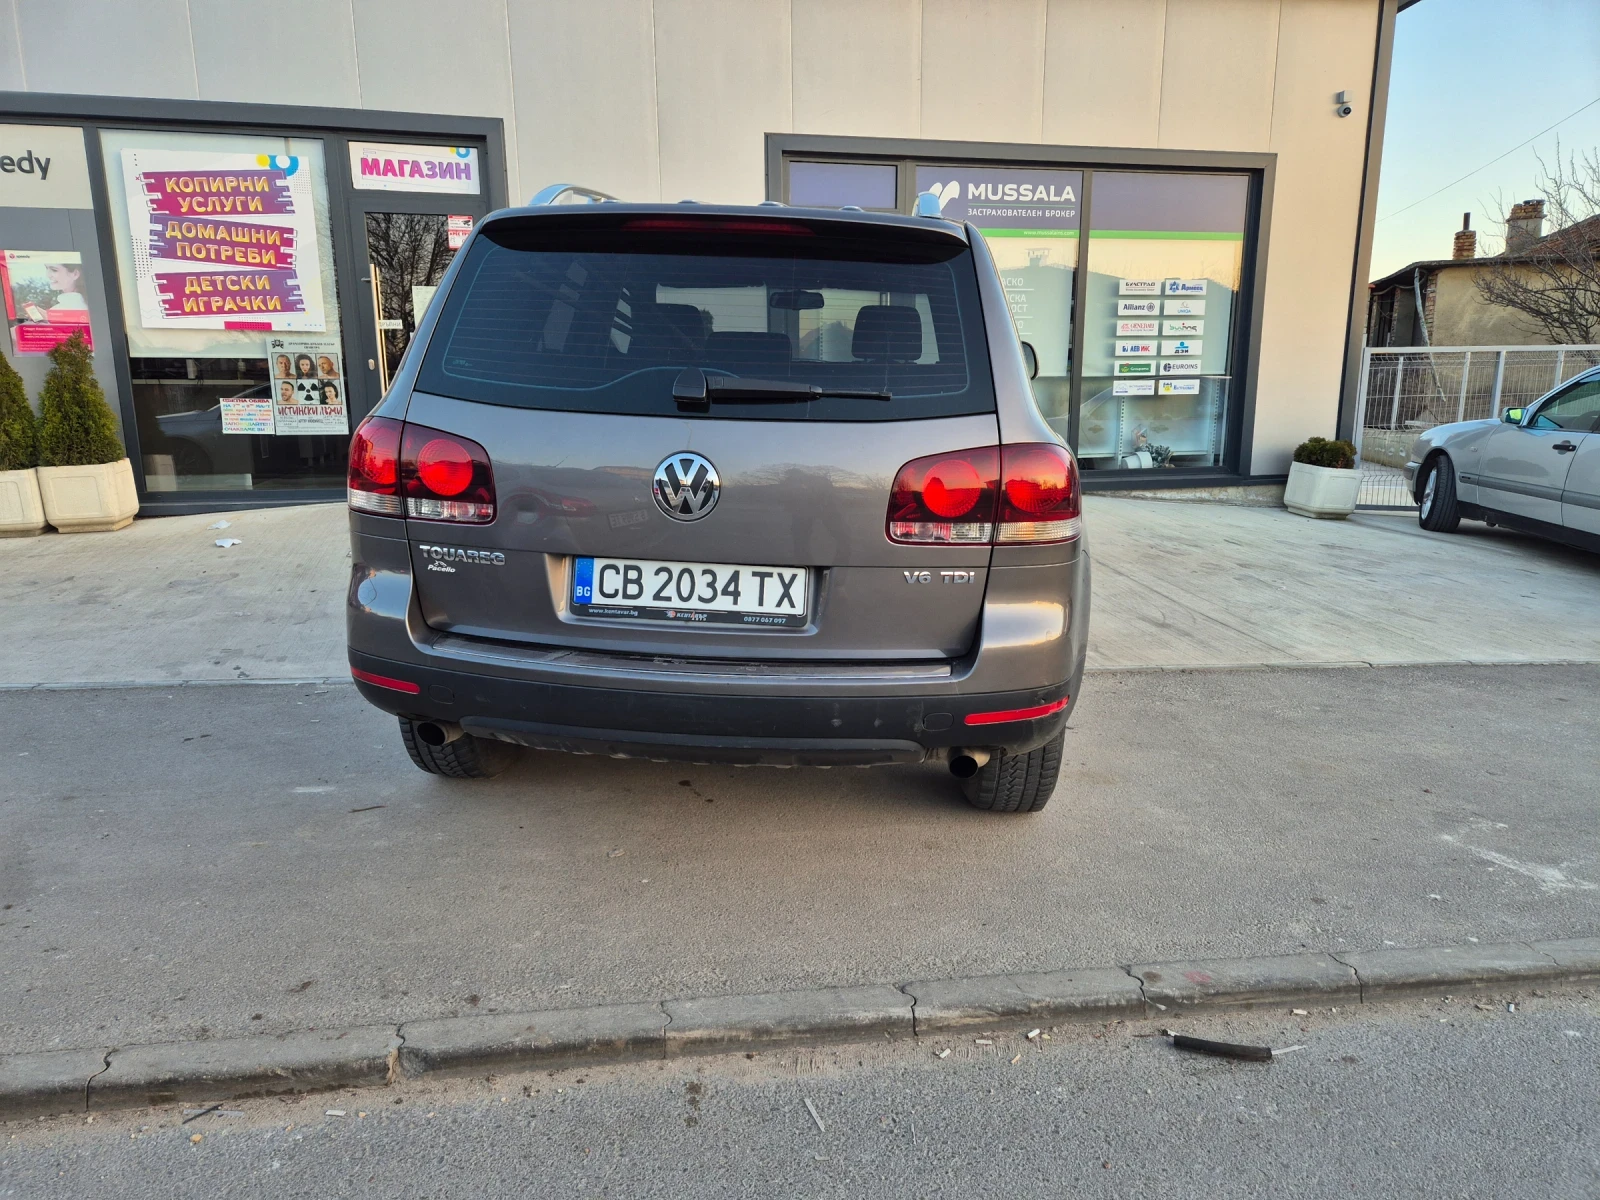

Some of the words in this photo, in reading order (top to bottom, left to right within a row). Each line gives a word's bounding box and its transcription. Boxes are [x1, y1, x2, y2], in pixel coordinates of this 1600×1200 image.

[0, 149, 51, 181] edy
[360, 157, 472, 181] МАГАЗИН
[164, 176, 269, 193] КОПИРНИ
[967, 183, 1076, 202] MUSSALA
[177, 196, 263, 213] УСЛУГИ
[967, 208, 1042, 217] ЗАСТРАХОВАТЕЛЕН
[1045, 209, 1076, 218] БРОКЕР
[165, 221, 281, 246] ДОМАШНИ
[176, 242, 277, 266] ПОТРЕБИ
[184, 275, 271, 295] ДЕТСКИ
[183, 295, 282, 313] ИГРАЧКИ
[1123, 303, 1146, 311] Allianz
[277, 406, 318, 416] ИСТИНСКИ
[419, 544, 506, 566] TOUAREG
[599, 563, 644, 600] CB
[652, 566, 741, 606] 2034
[751, 571, 798, 609] TX
[903, 571, 932, 584] V6
[940, 571, 975, 584] TDI
[576, 586, 591, 597] BG
